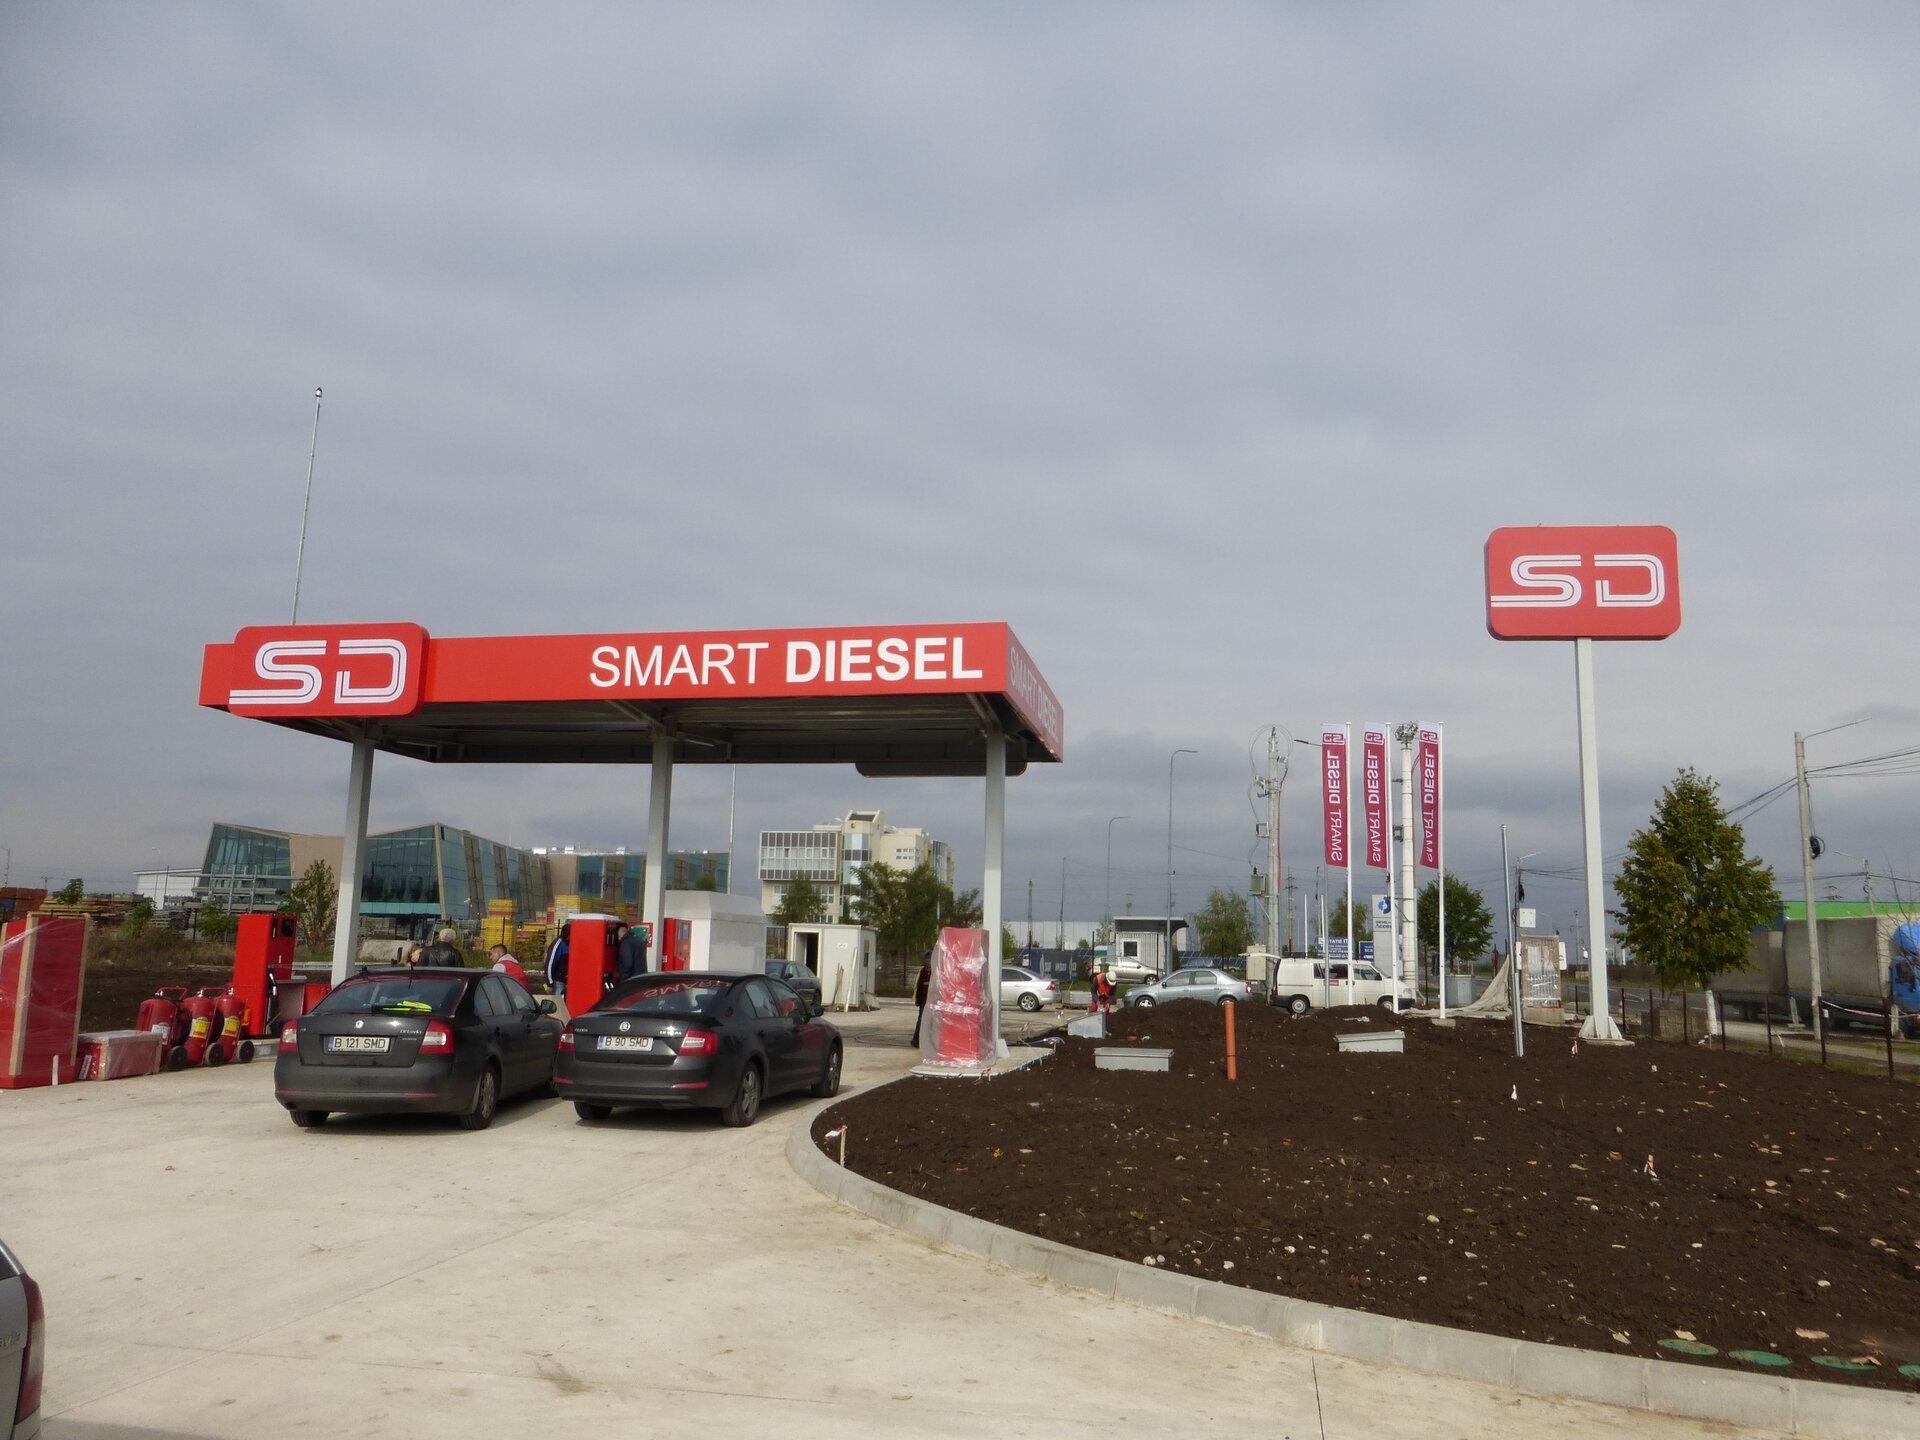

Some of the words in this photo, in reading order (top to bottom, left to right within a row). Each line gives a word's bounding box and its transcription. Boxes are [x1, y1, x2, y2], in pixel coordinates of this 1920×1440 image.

[1491, 554, 1665, 607] SD
[229, 638, 407, 704] SD
[589, 642, 769, 688] SMART
[786, 636, 983, 683] DIESEL
[1010, 646, 1037, 713] SMART
[334, 1038, 342, 1048] B
[346, 1038, 359, 1048] 121
[363, 1039, 386, 1048] SMD
[605, 1037, 612, 1047] B
[615, 1037, 626, 1047] 90
[629, 1038, 649, 1048] SMD
